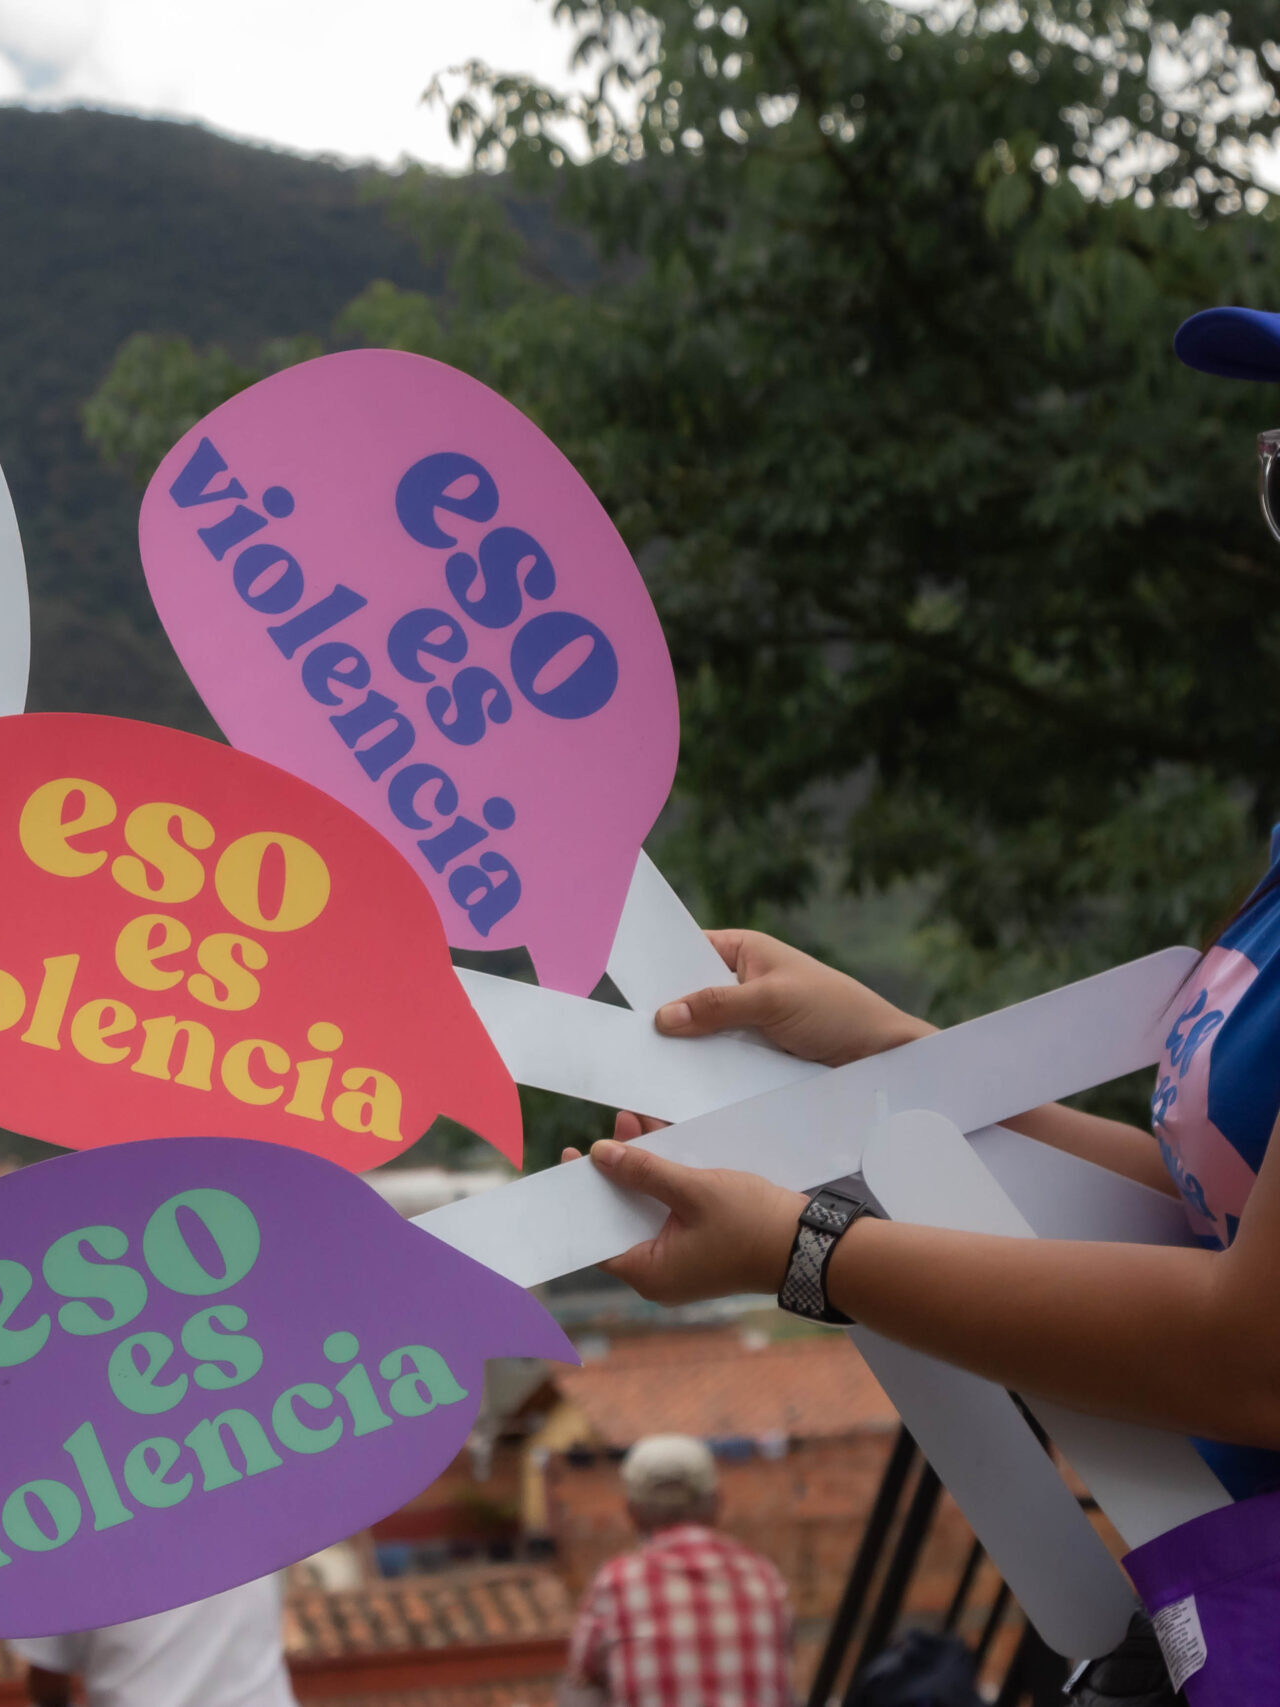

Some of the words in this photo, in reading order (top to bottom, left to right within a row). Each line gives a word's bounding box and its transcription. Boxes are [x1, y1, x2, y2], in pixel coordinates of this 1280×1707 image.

[395, 452, 619, 720] eso
[169, 437, 522, 937] violencia
[387, 607, 513, 746] es
[19, 778, 330, 932] eso
[115, 914, 268, 1010] es
[107, 1304, 264, 1415] es
